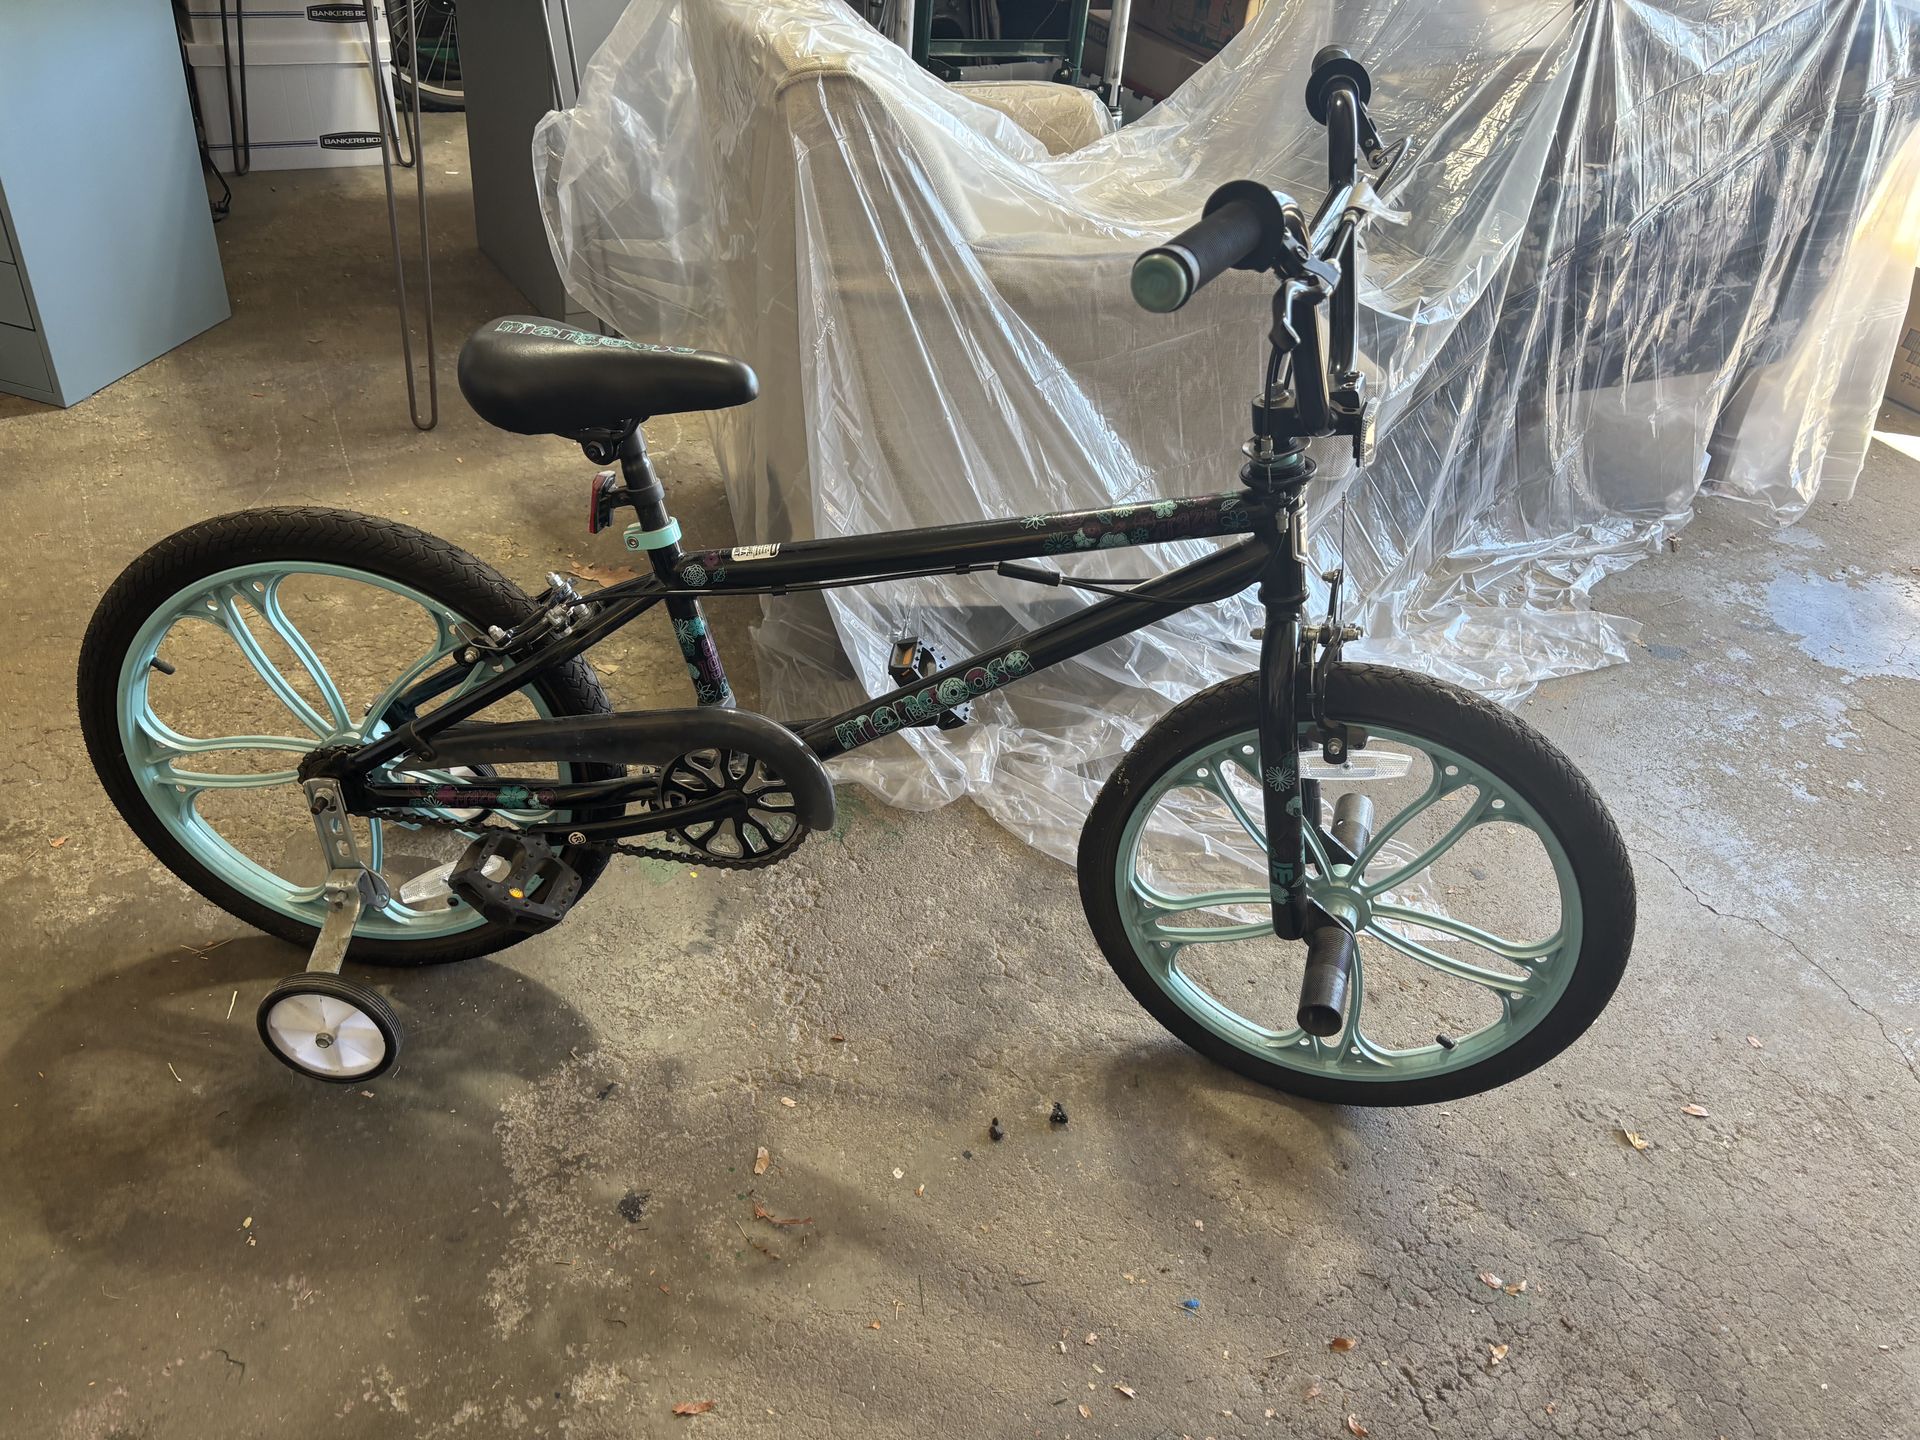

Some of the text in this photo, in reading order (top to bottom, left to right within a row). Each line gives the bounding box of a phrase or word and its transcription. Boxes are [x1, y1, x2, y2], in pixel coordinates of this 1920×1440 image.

[311, 9, 367, 17] BANKERS BO
[324, 137, 366, 145] BANKERS
[494, 320, 697, 355] mongoose
[834, 649, 1035, 750] mongoose
